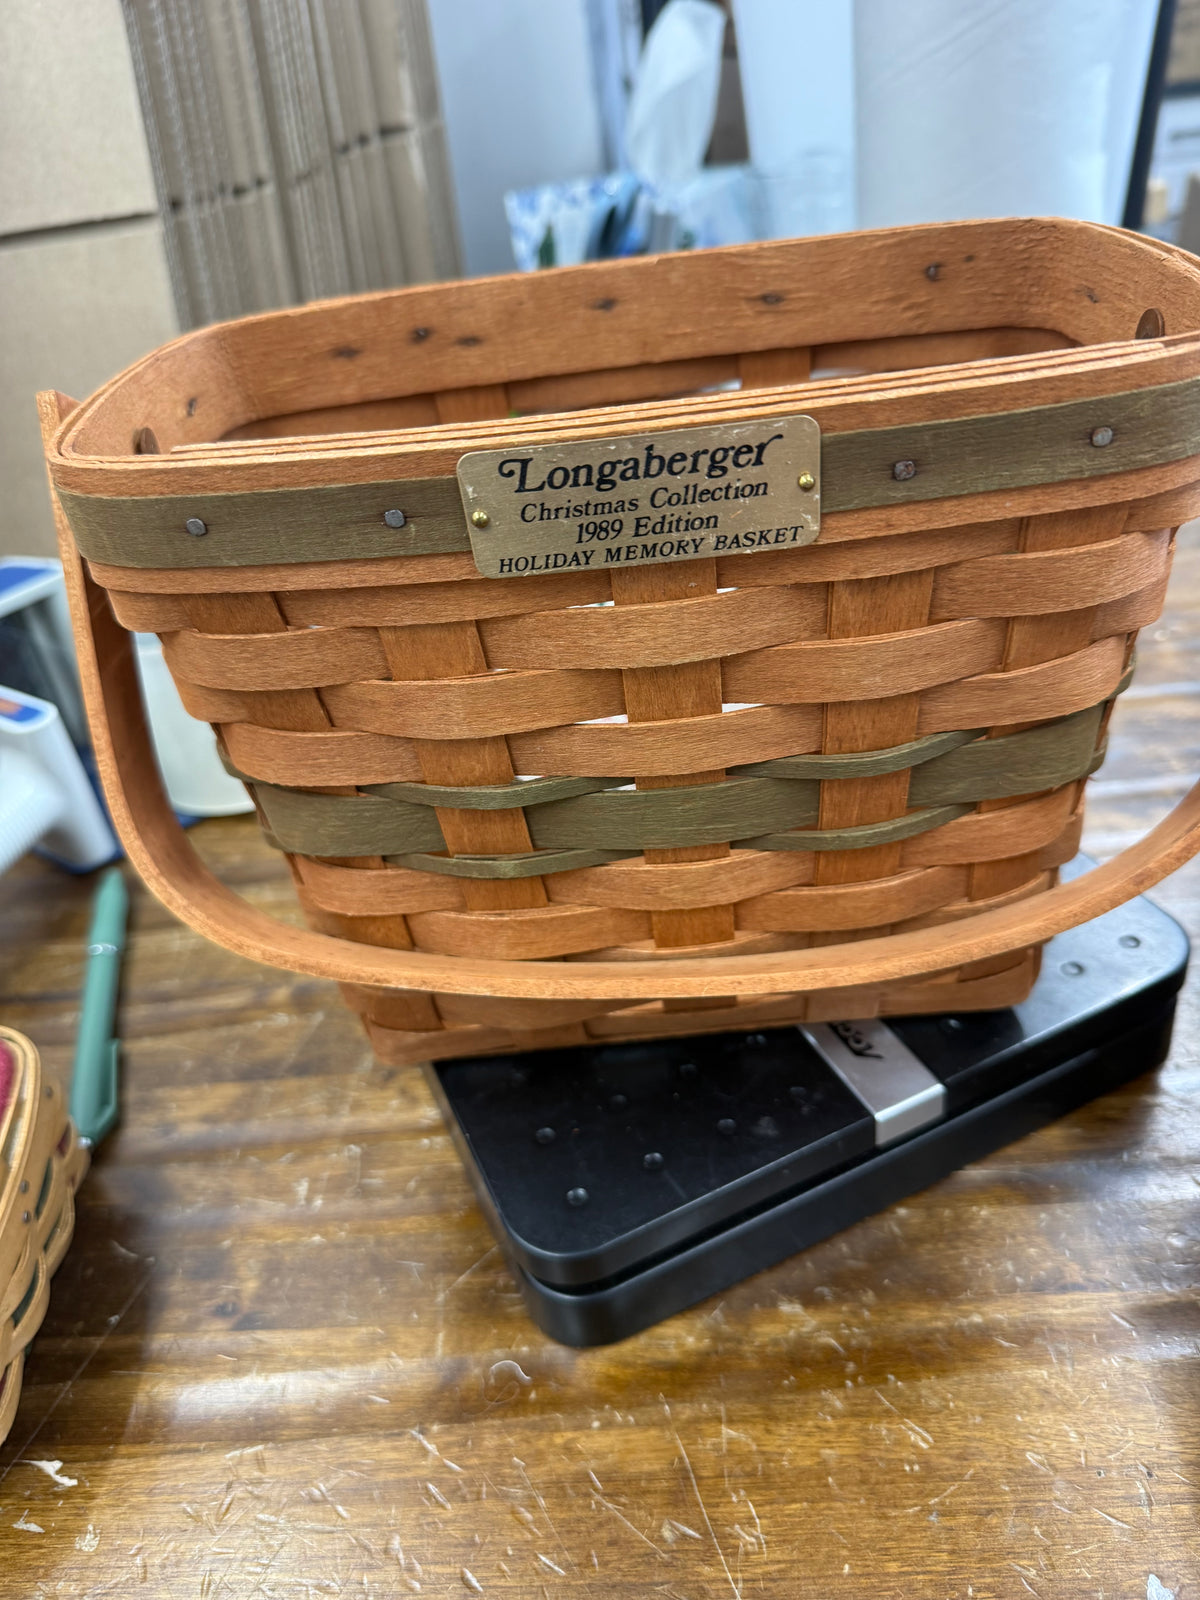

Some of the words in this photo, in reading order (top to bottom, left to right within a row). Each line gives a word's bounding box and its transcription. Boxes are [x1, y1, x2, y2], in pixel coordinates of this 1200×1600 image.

[498, 434, 783, 493] Longaberger
[520, 498, 639, 523] Christmas
[650, 478, 769, 509] Collection
[498, 550, 596, 573] HOLIDAY
[604, 538, 705, 563] MEMORY
[713, 525, 804, 551] BASKET
[575, 519, 623, 544] 1989
[632, 512, 719, 538] Edition
